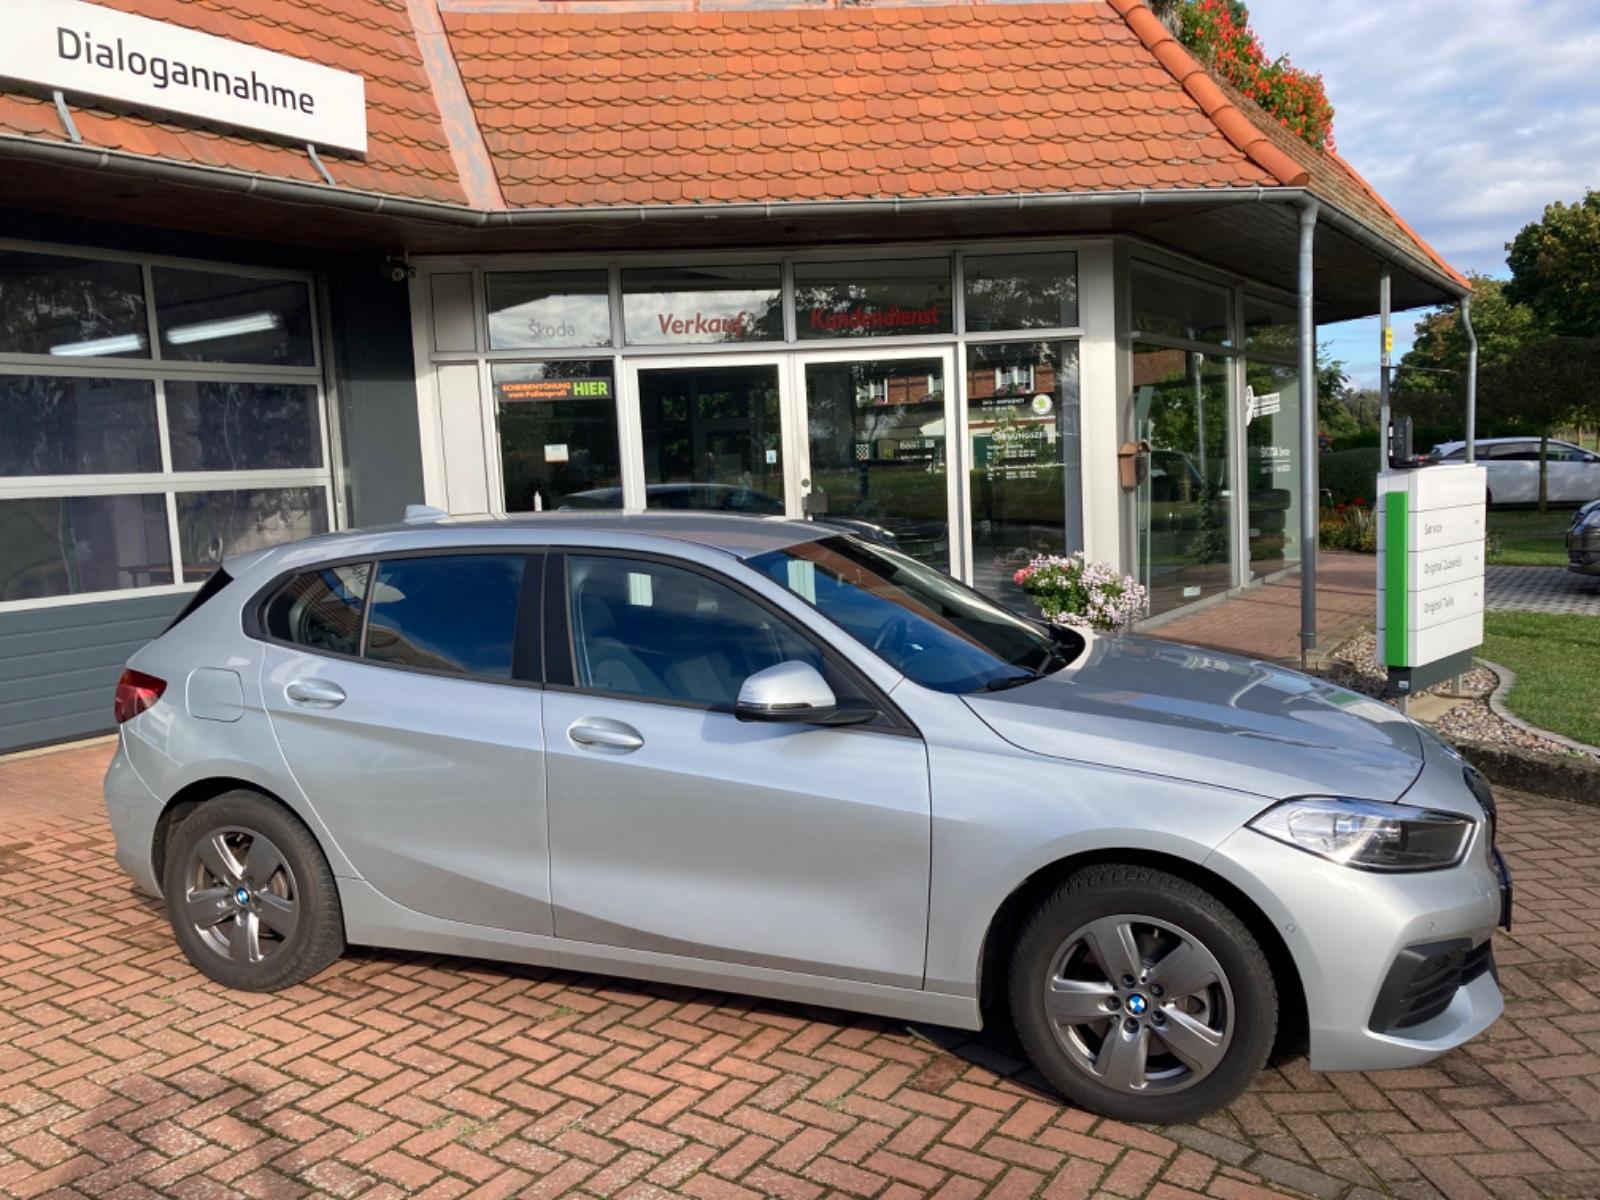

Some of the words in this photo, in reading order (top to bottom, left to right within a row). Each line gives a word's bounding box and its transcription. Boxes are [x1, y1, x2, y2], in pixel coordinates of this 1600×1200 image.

[57, 26, 315, 115] Dialogannahme
[658, 311, 747, 337] Verkauf
[810, 304, 940, 329] Kundendienst
[527, 318, 576, 339] Škoda
[573, 382, 608, 396] HIER
[1424, 523, 1443, 535] Service
